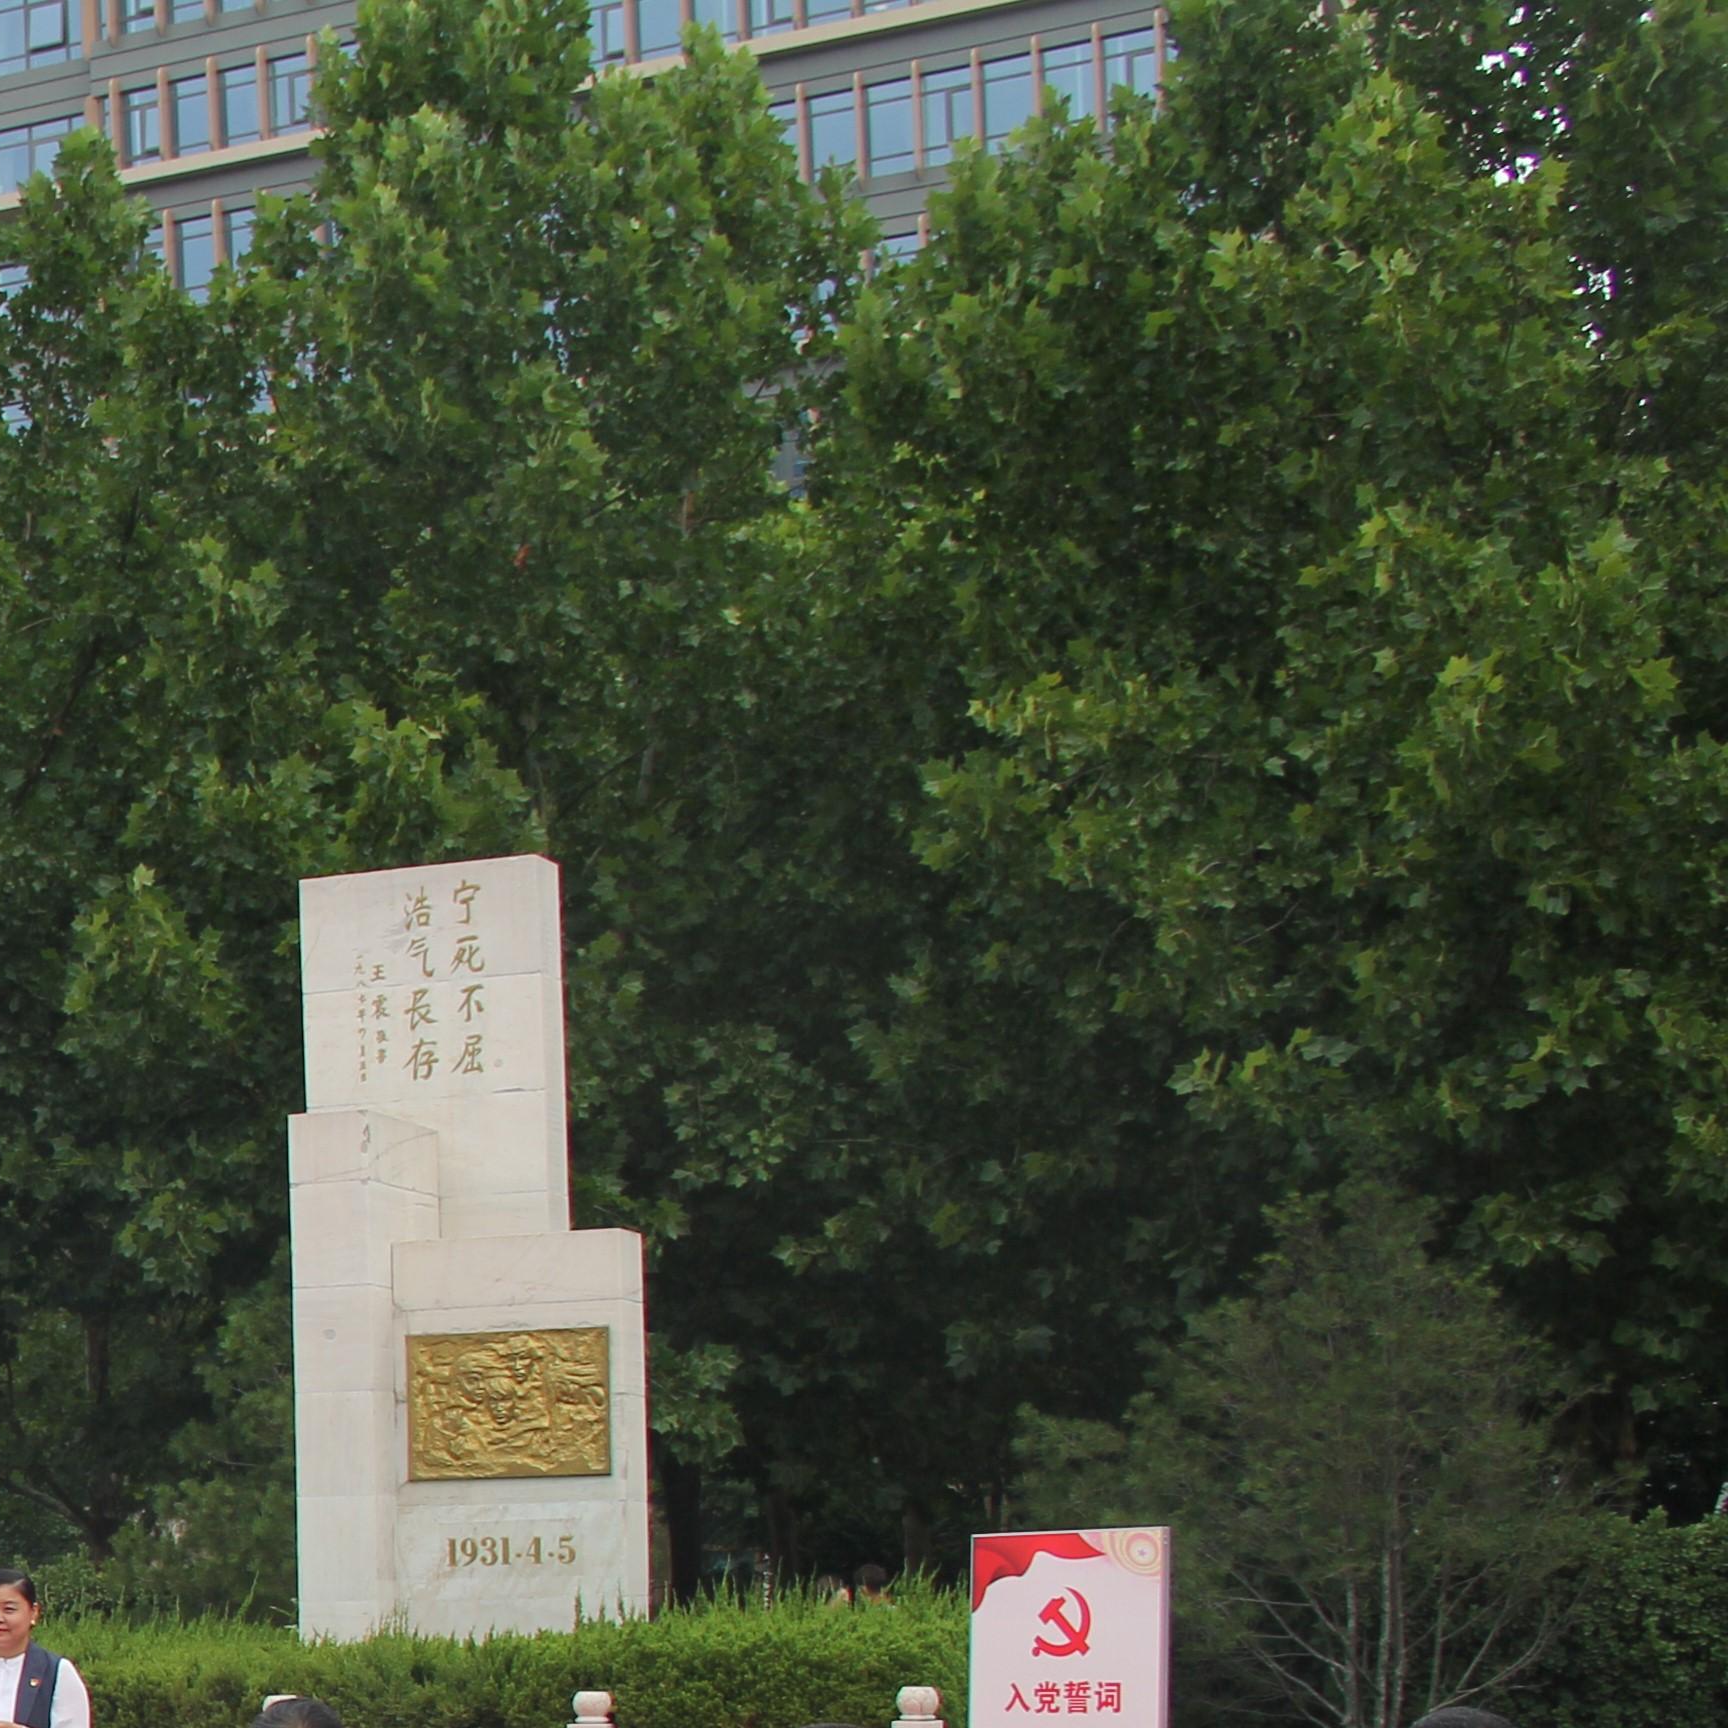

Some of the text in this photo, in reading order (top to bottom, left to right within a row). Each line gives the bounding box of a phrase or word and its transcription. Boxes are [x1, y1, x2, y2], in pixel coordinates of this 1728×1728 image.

[450, 879, 486, 1075] 宁死不屈
[1005, 1681, 1122, 1714] 入党誓词
